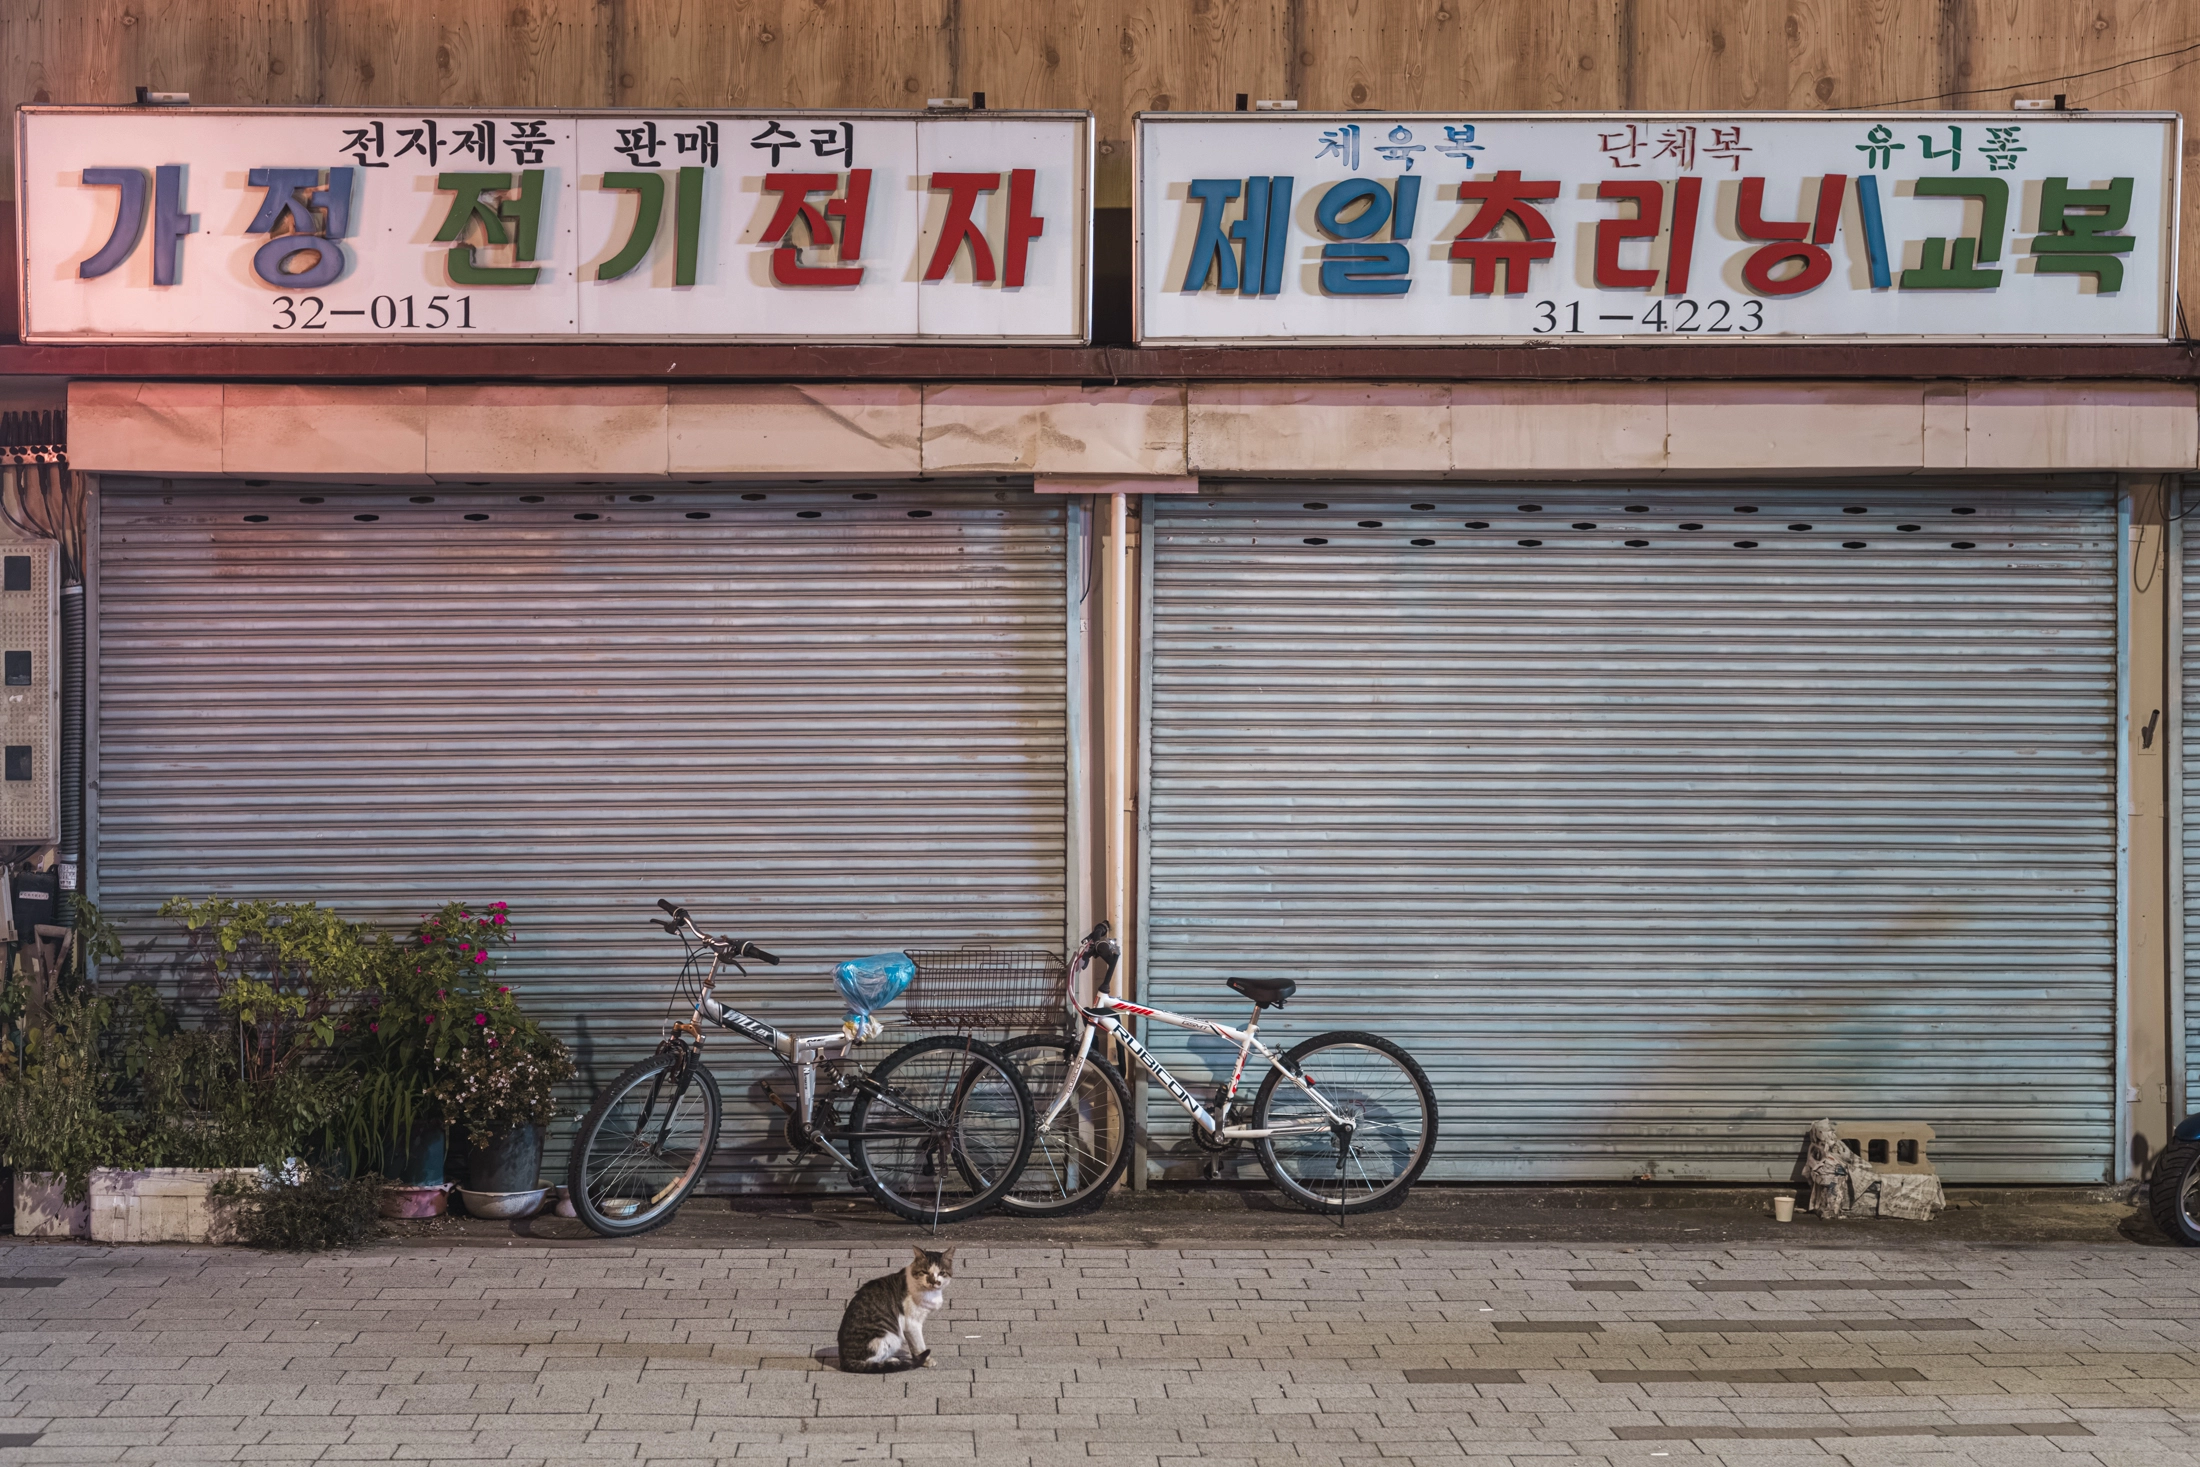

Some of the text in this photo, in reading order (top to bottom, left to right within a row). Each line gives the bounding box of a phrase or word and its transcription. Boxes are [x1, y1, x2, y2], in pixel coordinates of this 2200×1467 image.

[339, 119, 855, 168] 전자제품 판매 수리
[1314, 124, 2028, 172] 체육복 단체복 유니폼
[272, 295, 477, 330] 32-0151
[1532, 299, 1764, 334] 31-4223
[722, 1009, 758, 1031] WILL
[1113, 1024, 1200, 1113] RUBICON
